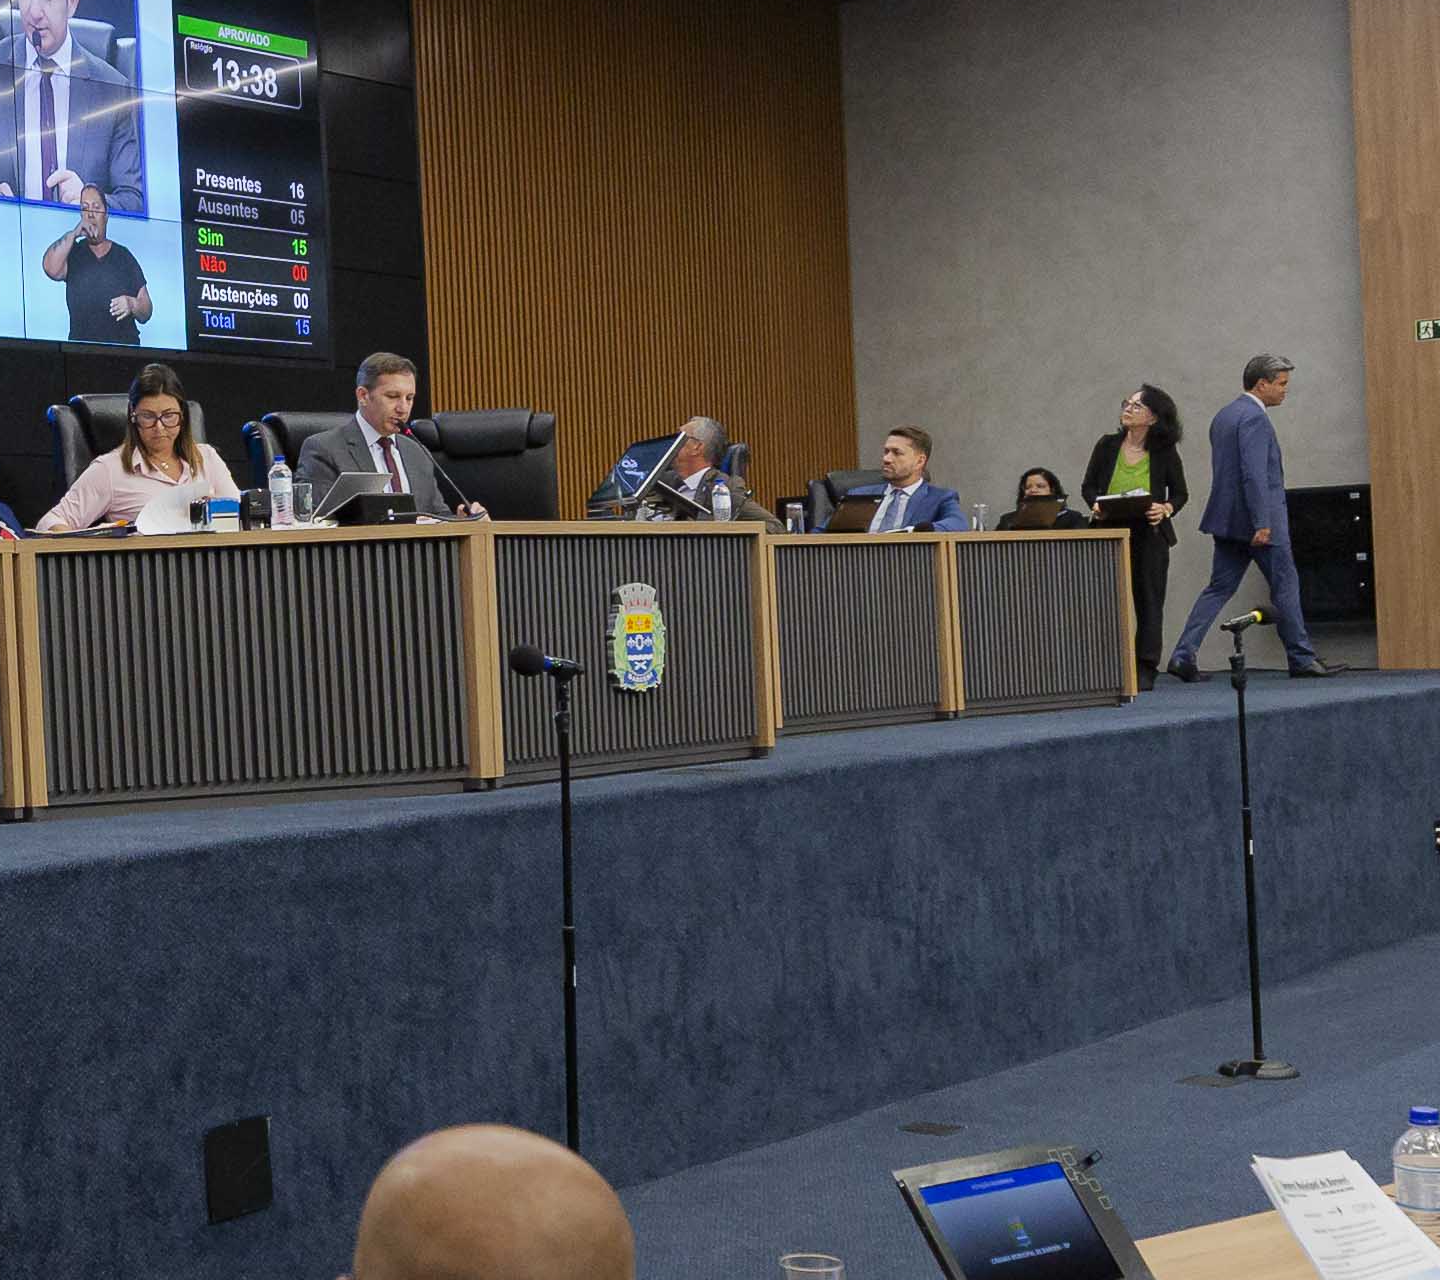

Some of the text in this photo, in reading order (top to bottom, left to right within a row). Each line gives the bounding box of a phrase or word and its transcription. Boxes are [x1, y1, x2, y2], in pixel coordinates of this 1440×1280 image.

[217, 24, 270, 48] APROVADO
[212, 56, 278, 98] 13:38
[195, 167, 304, 199] Presentes 16
[197, 195, 305, 225] Ausentes 05
[197, 226, 307, 256] Sim 15
[199, 253, 307, 281] Não 00
[200, 282, 308, 309] Abstenções 00
[202, 309, 310, 335] Total 15
